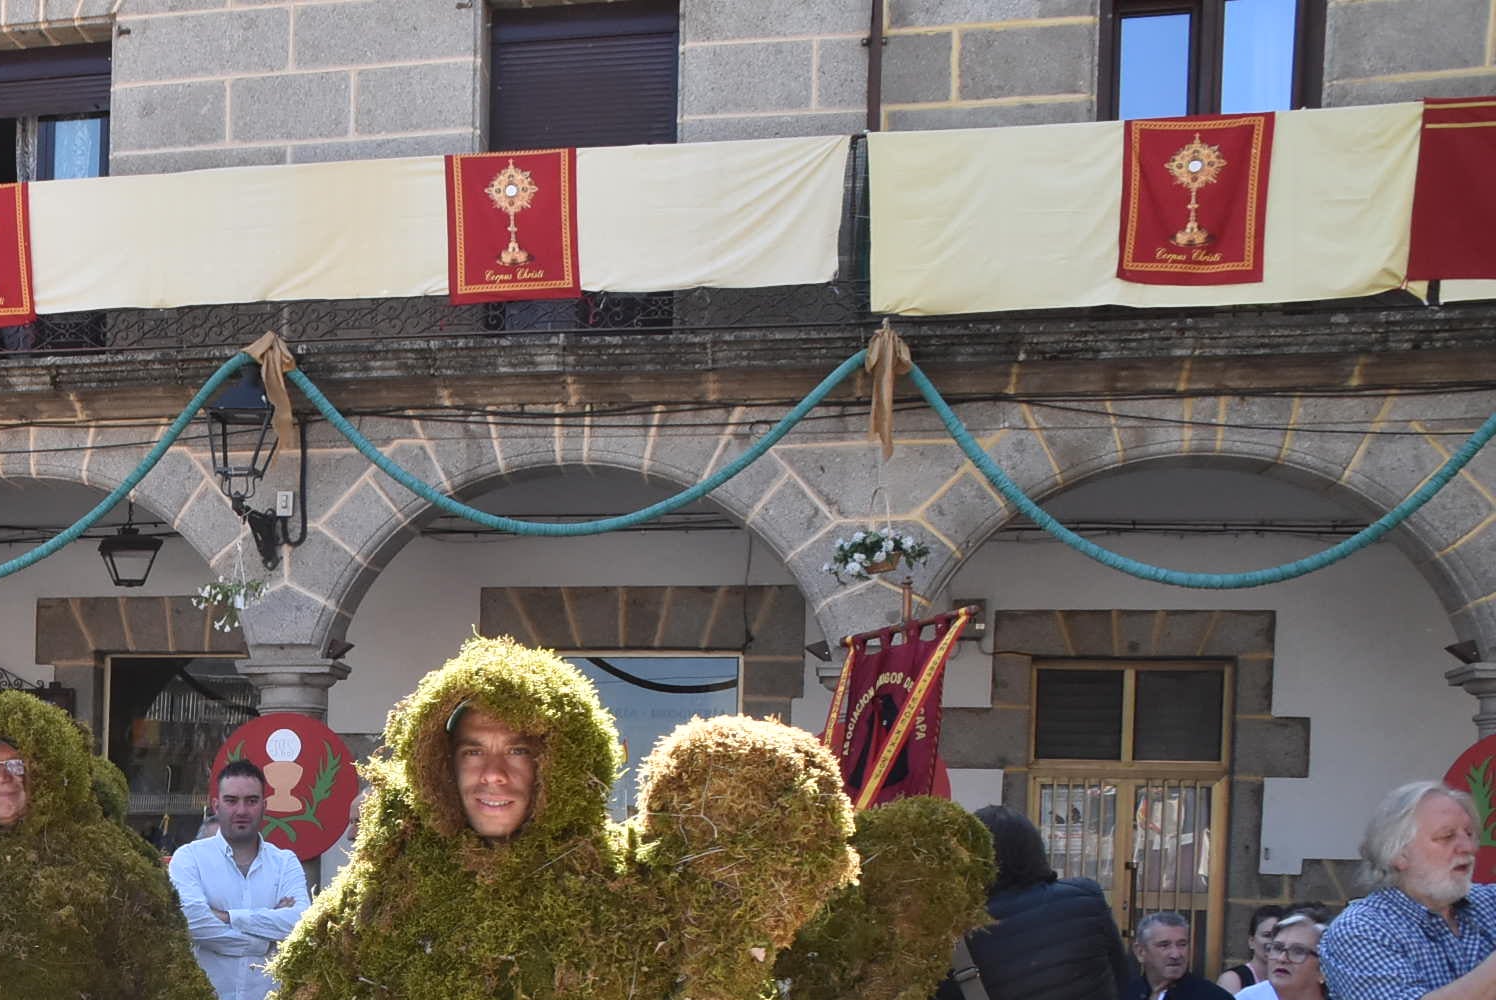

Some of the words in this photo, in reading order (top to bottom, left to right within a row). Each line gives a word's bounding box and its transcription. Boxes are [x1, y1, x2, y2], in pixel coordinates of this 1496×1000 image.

[1155, 247, 1186, 264] Corpus
[1191, 249, 1223, 261] Christi
[485, 269, 512, 283] Corpus
[515, 267, 544, 279] Christi
[876, 672, 904, 690] AMIGOS
